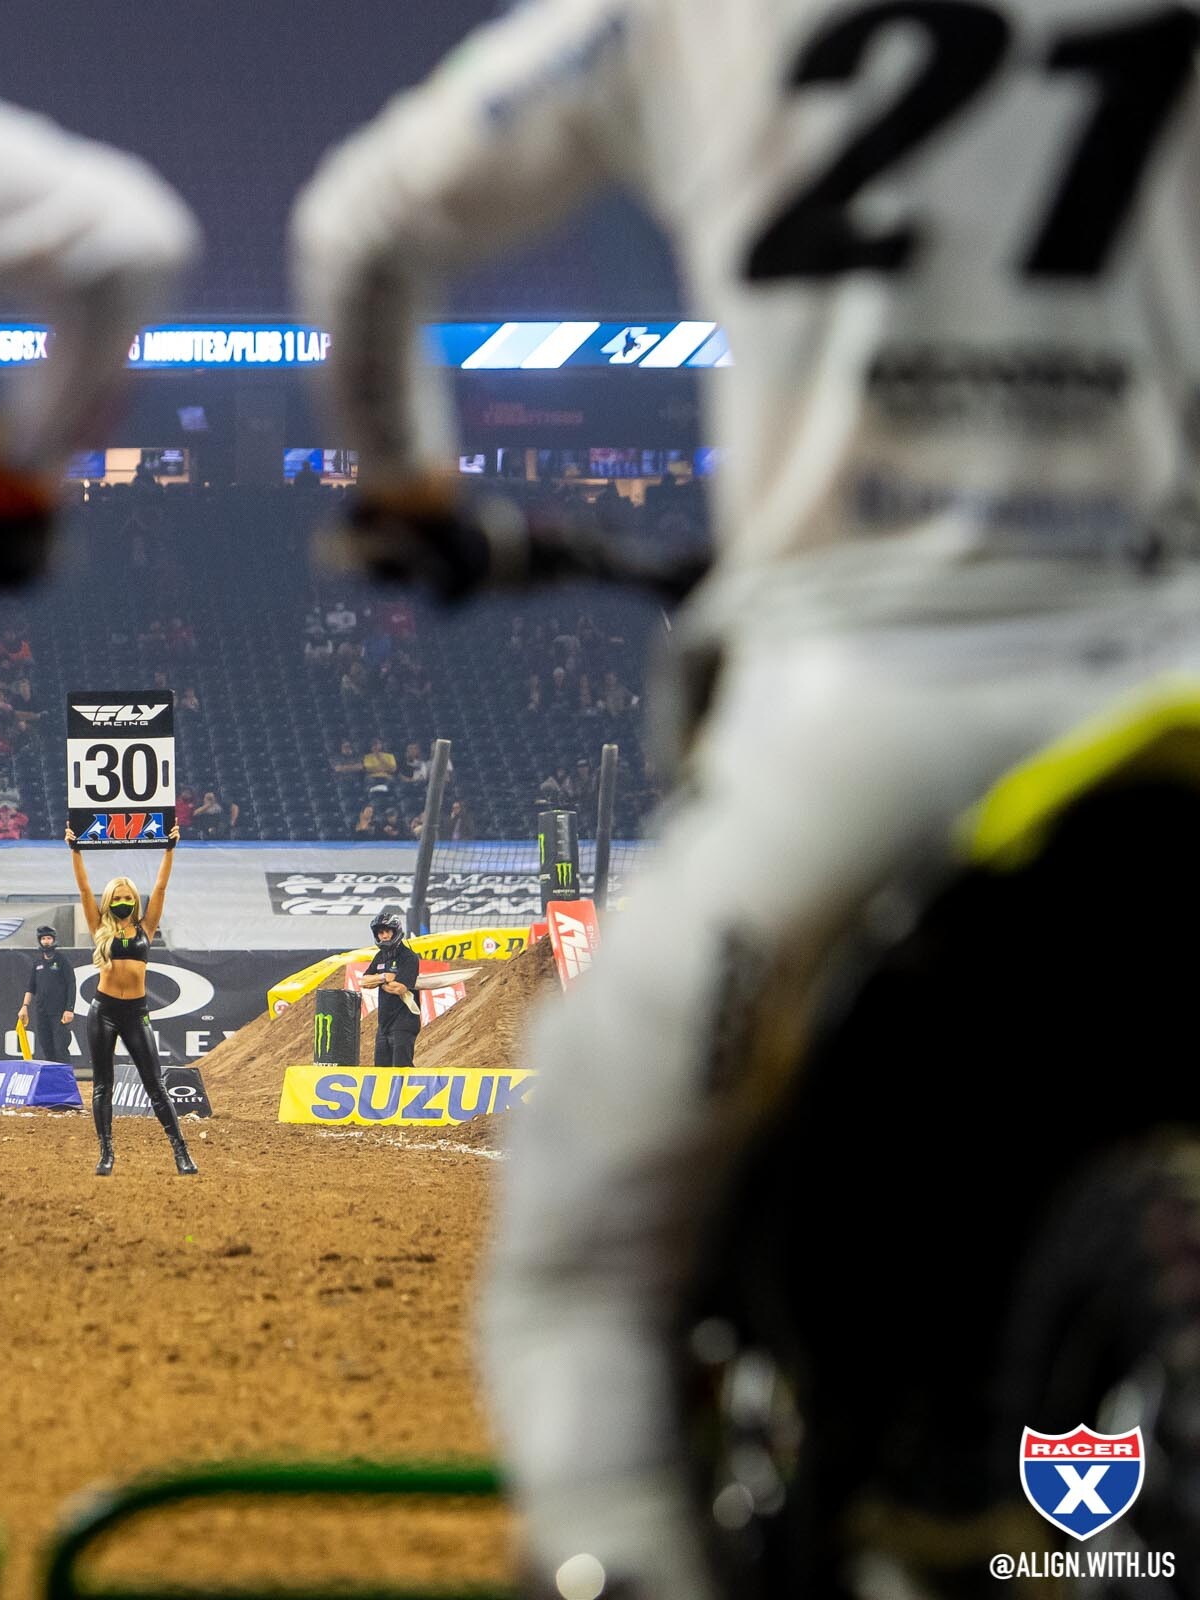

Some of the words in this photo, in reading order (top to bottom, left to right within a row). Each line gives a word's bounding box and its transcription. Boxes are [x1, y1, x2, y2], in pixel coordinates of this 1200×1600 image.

[741, 0, 1199, 280] 21
[284, 331, 294, 361] 1
[297, 331, 331, 361] LAP
[72, 704, 169, 721] FLY
[85, 743, 158, 802] 30
[77, 813, 169, 840] AMA
[112, 1081, 153, 1107] OAKLE
[311, 1075, 539, 1121] SUZUK
